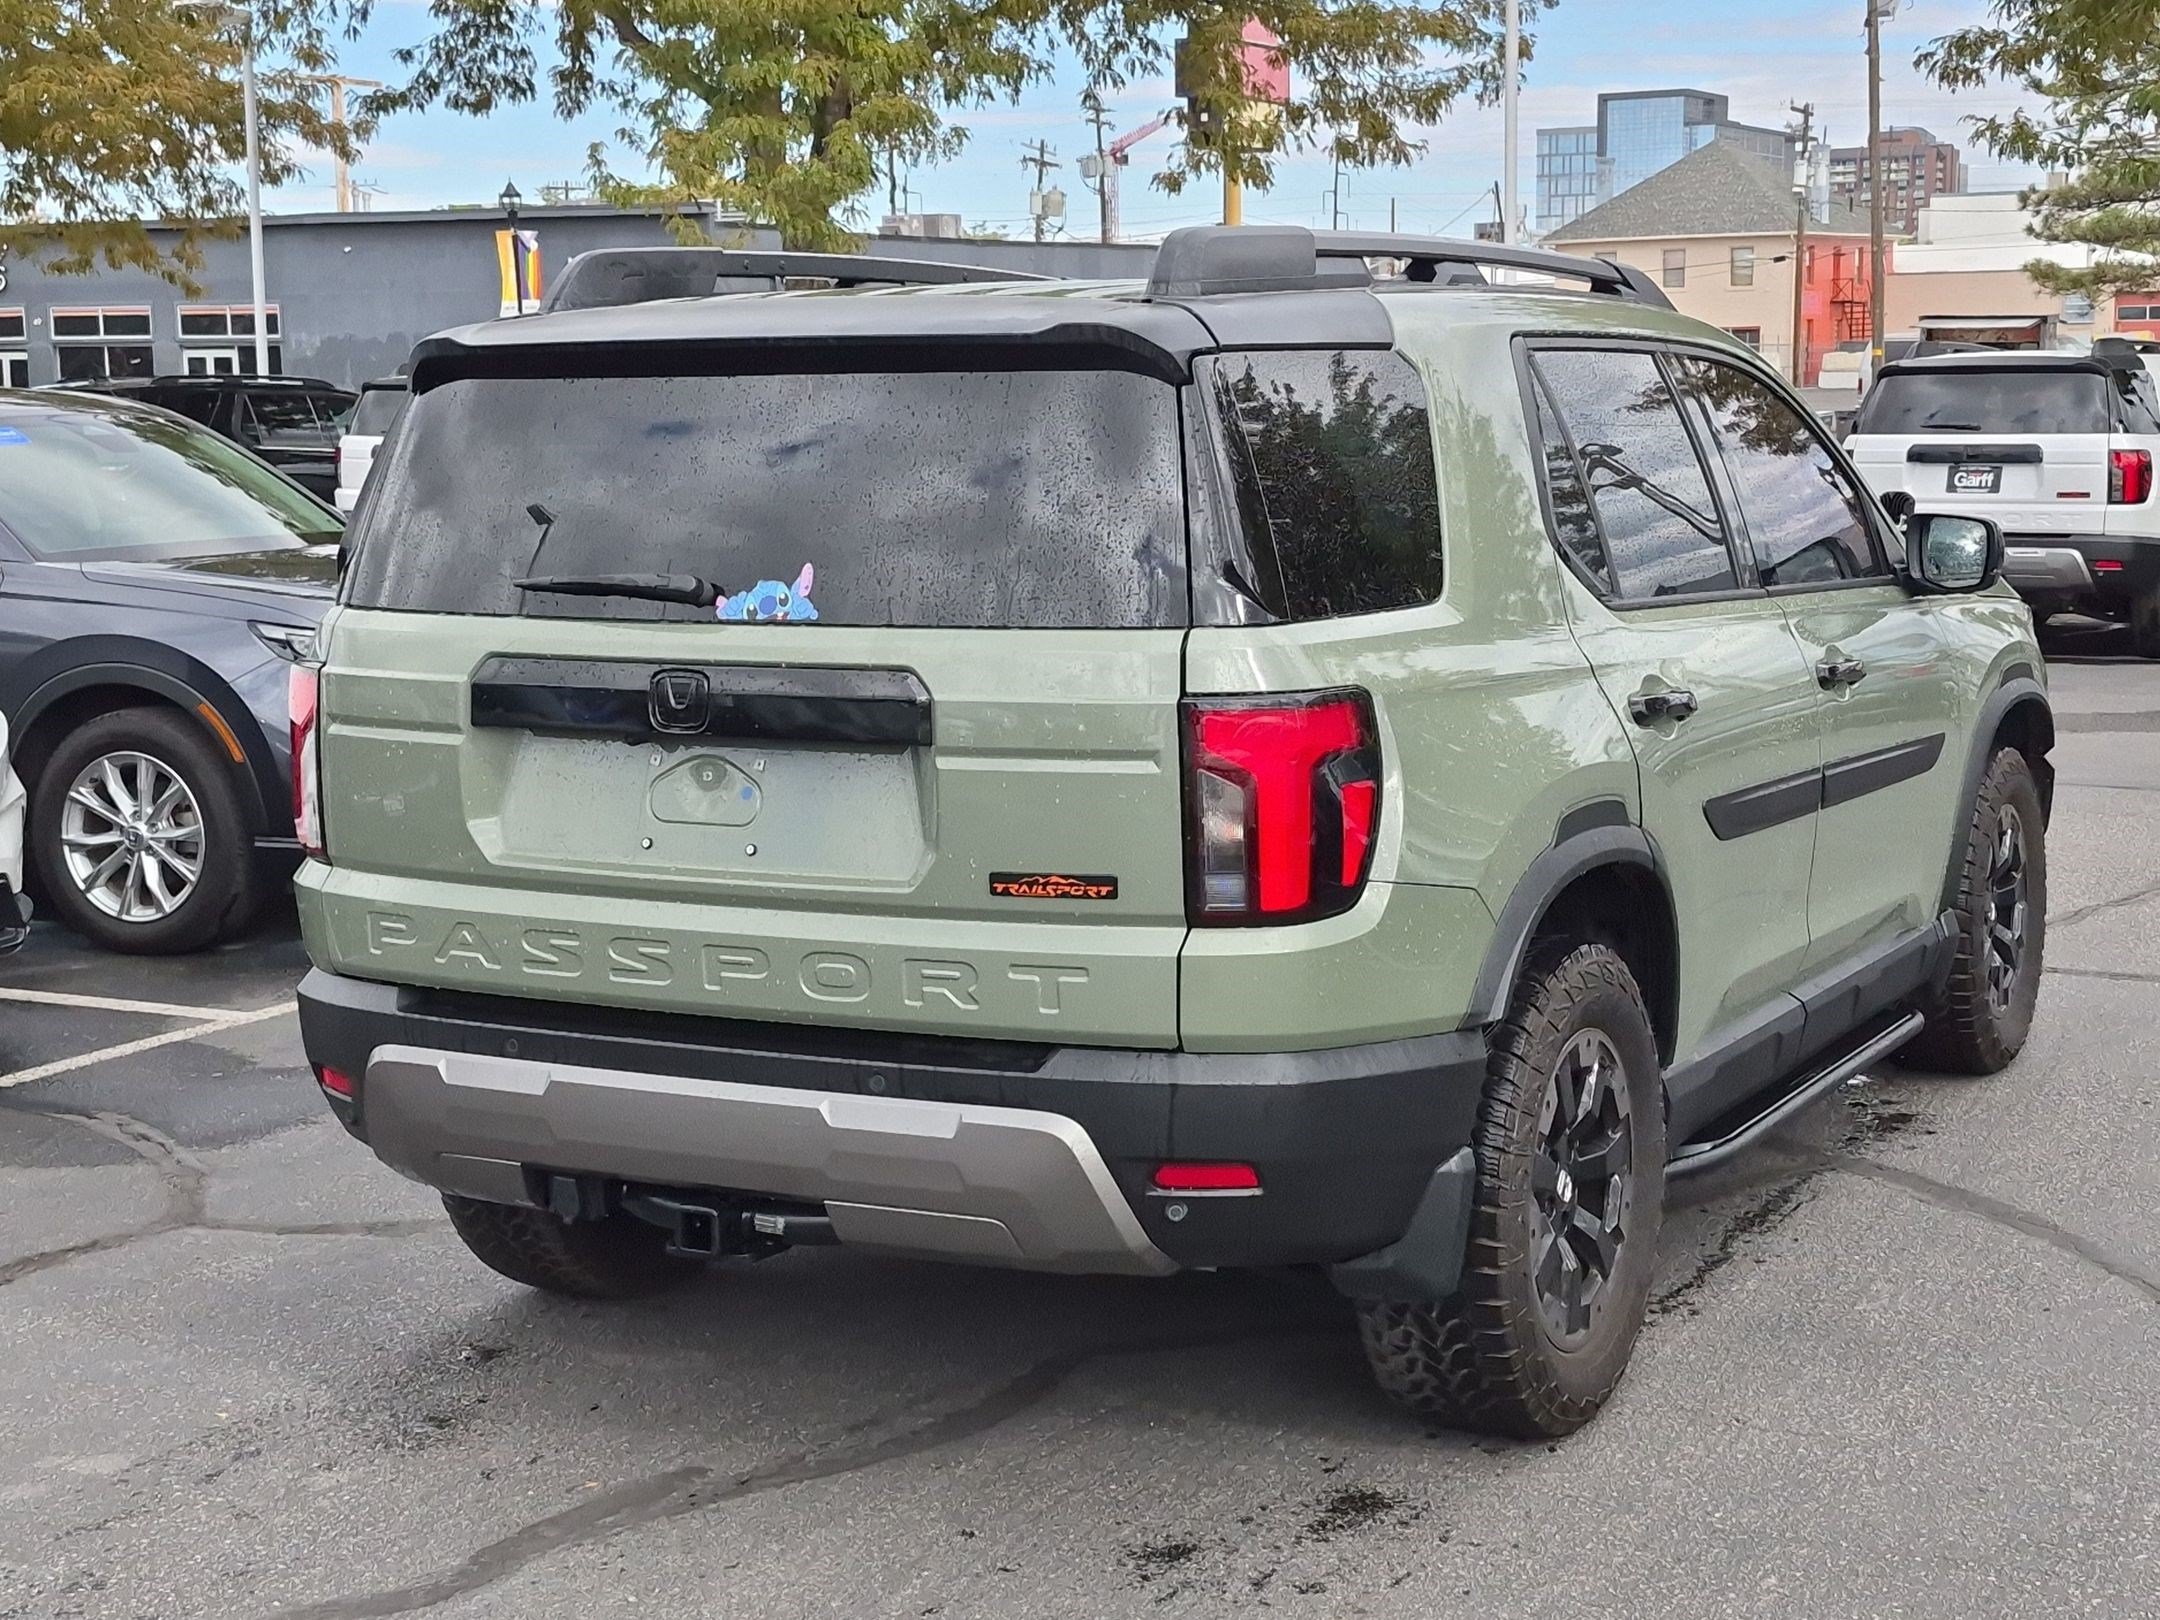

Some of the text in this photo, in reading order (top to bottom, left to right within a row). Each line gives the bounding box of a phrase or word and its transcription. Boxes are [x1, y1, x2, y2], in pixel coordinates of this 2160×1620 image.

[1953, 471, 1995, 487] Garff
[992, 882, 1114, 898] TRAILSPORT
[366, 910, 1090, 1014] PASSPORT
